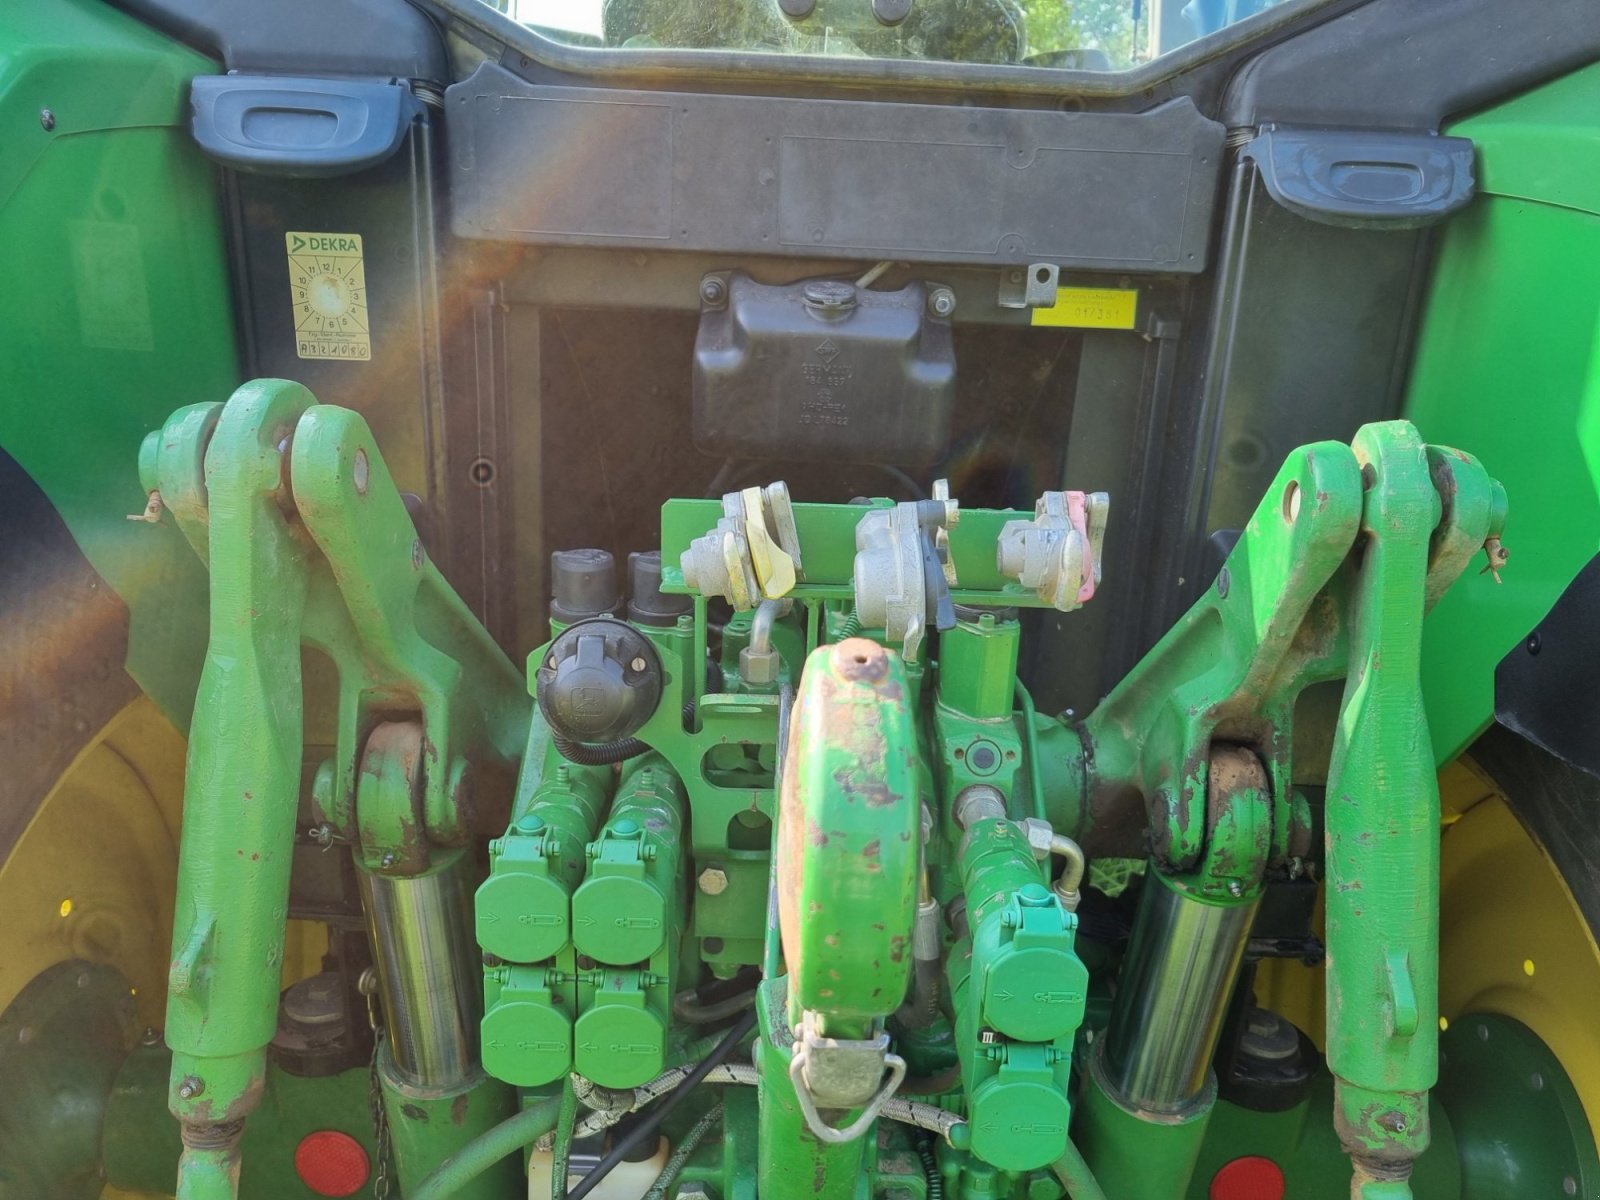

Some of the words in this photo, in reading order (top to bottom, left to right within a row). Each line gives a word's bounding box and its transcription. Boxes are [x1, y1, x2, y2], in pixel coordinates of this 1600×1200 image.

[309, 237, 358, 251] DEKRA
[322, 263, 331, 271] 12
[299, 276, 307, 284] 10
[349, 278, 355, 286] 2
